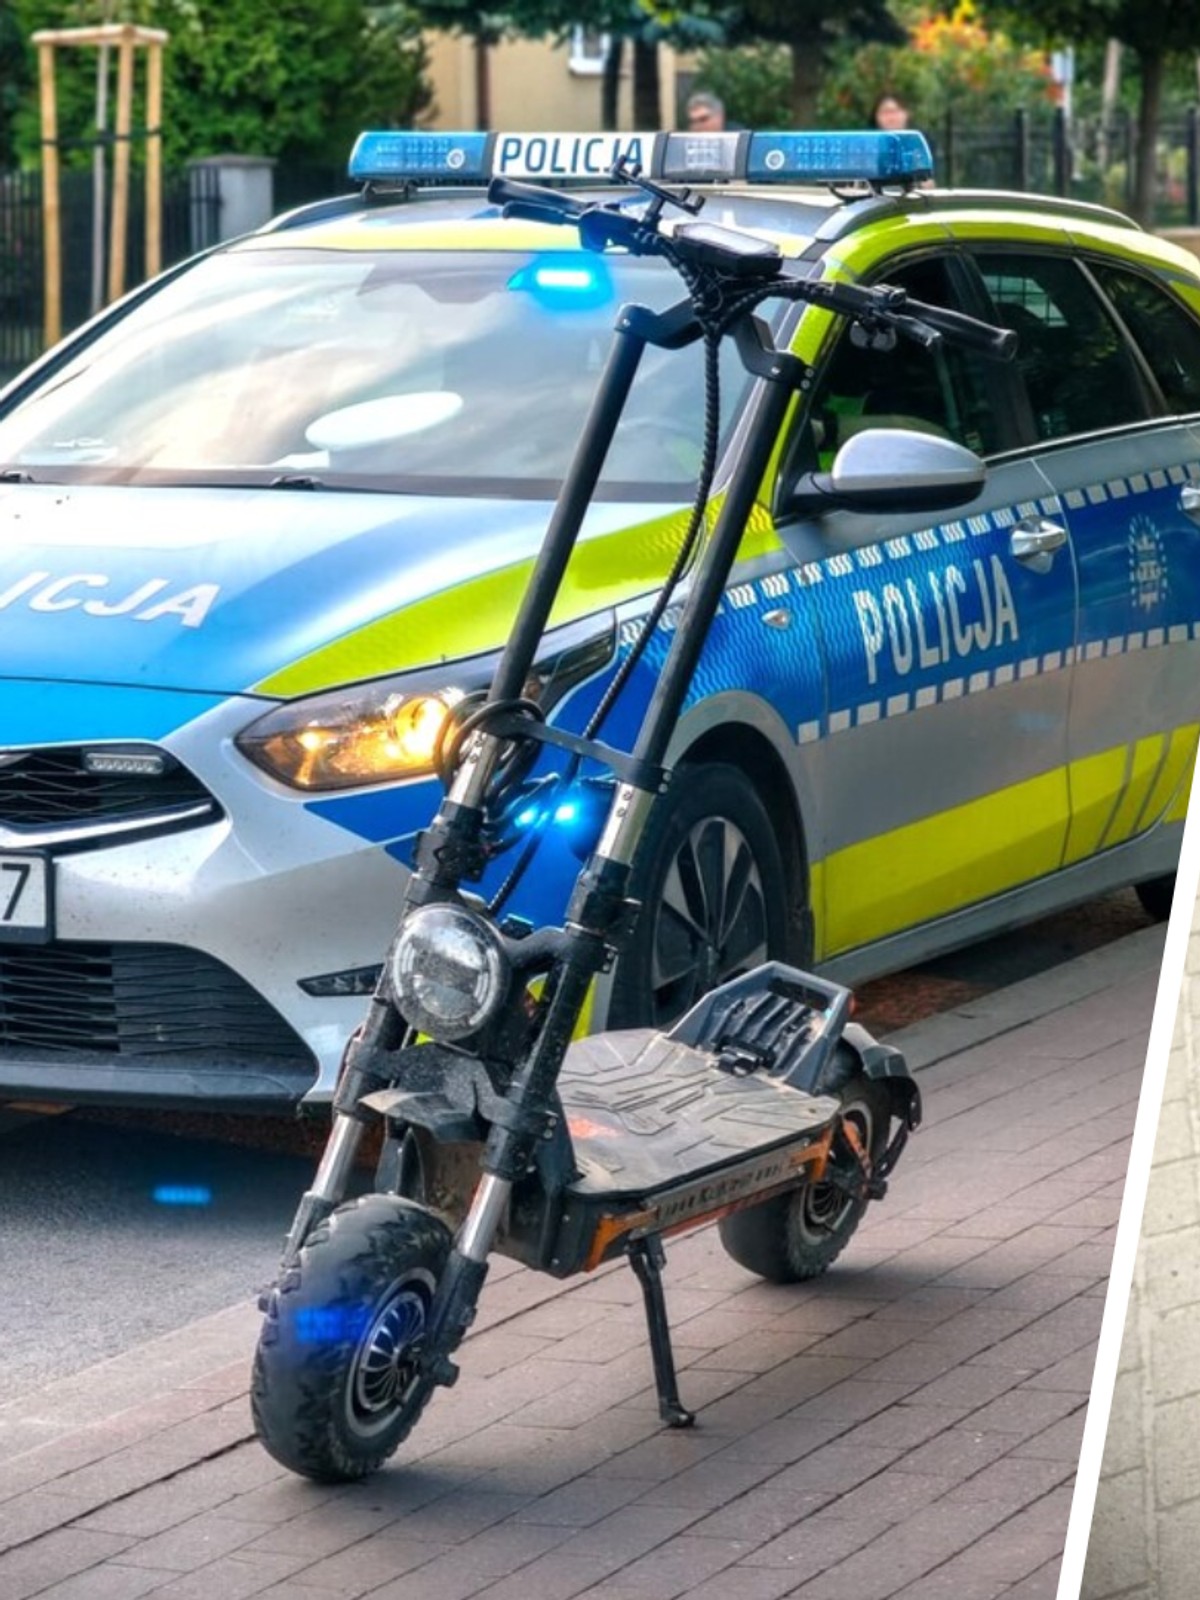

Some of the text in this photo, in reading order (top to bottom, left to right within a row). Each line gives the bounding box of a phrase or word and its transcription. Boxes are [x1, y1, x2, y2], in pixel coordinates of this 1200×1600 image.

[499, 137, 642, 173] POLICJA
[852, 554, 1019, 684] POLICJA
[1, 862, 31, 922] 7
